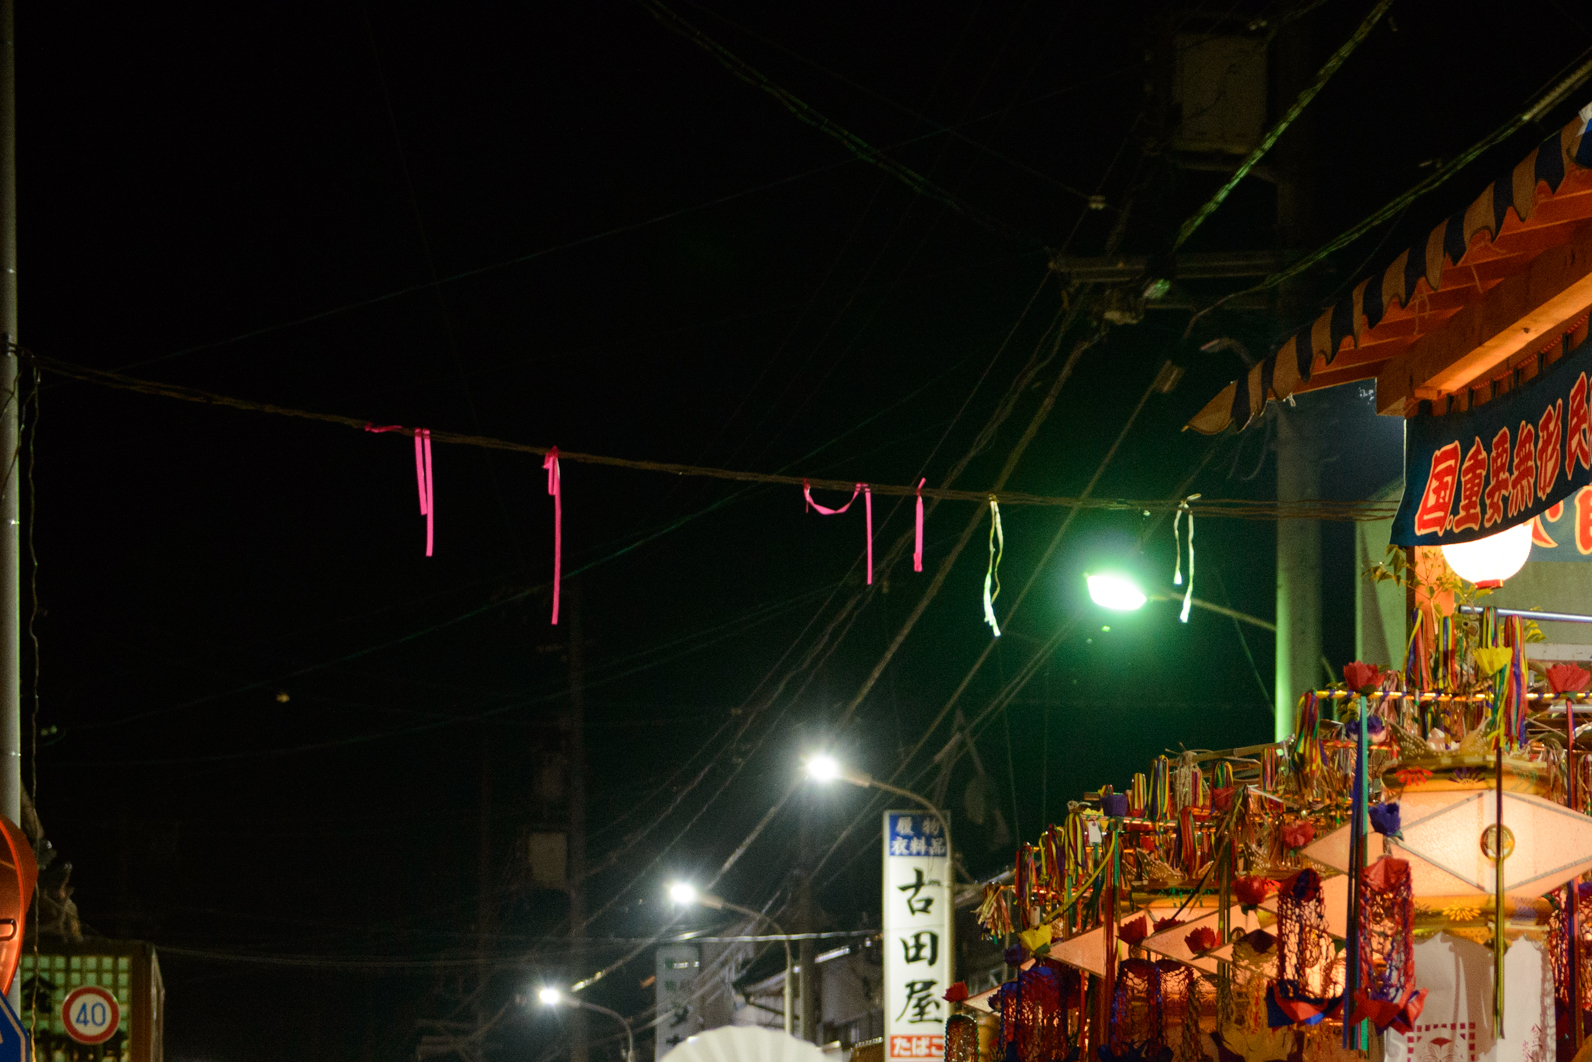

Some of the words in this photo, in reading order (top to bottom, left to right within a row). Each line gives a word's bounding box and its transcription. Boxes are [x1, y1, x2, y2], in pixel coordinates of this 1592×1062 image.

[894, 867, 943, 1024] 古田屋
[75, 1002, 106, 1027] 40
[893, 1036, 945, 1056] たばこ
